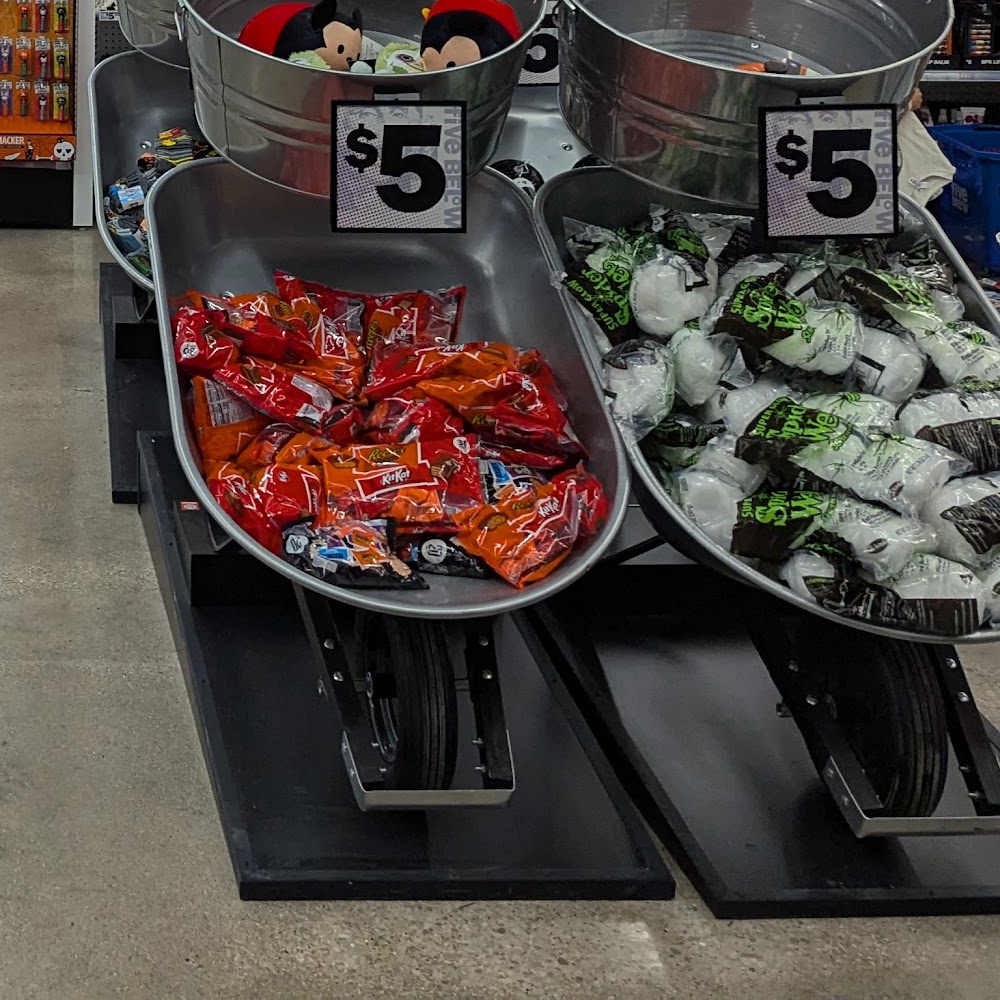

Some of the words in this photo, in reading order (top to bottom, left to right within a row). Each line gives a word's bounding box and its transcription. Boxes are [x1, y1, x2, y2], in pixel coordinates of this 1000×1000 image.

[344, 123, 446, 213] $5
[774, 128, 877, 219] $5
[567, 279, 592, 302] GLOW
[590, 302, 619, 331] SUPER
